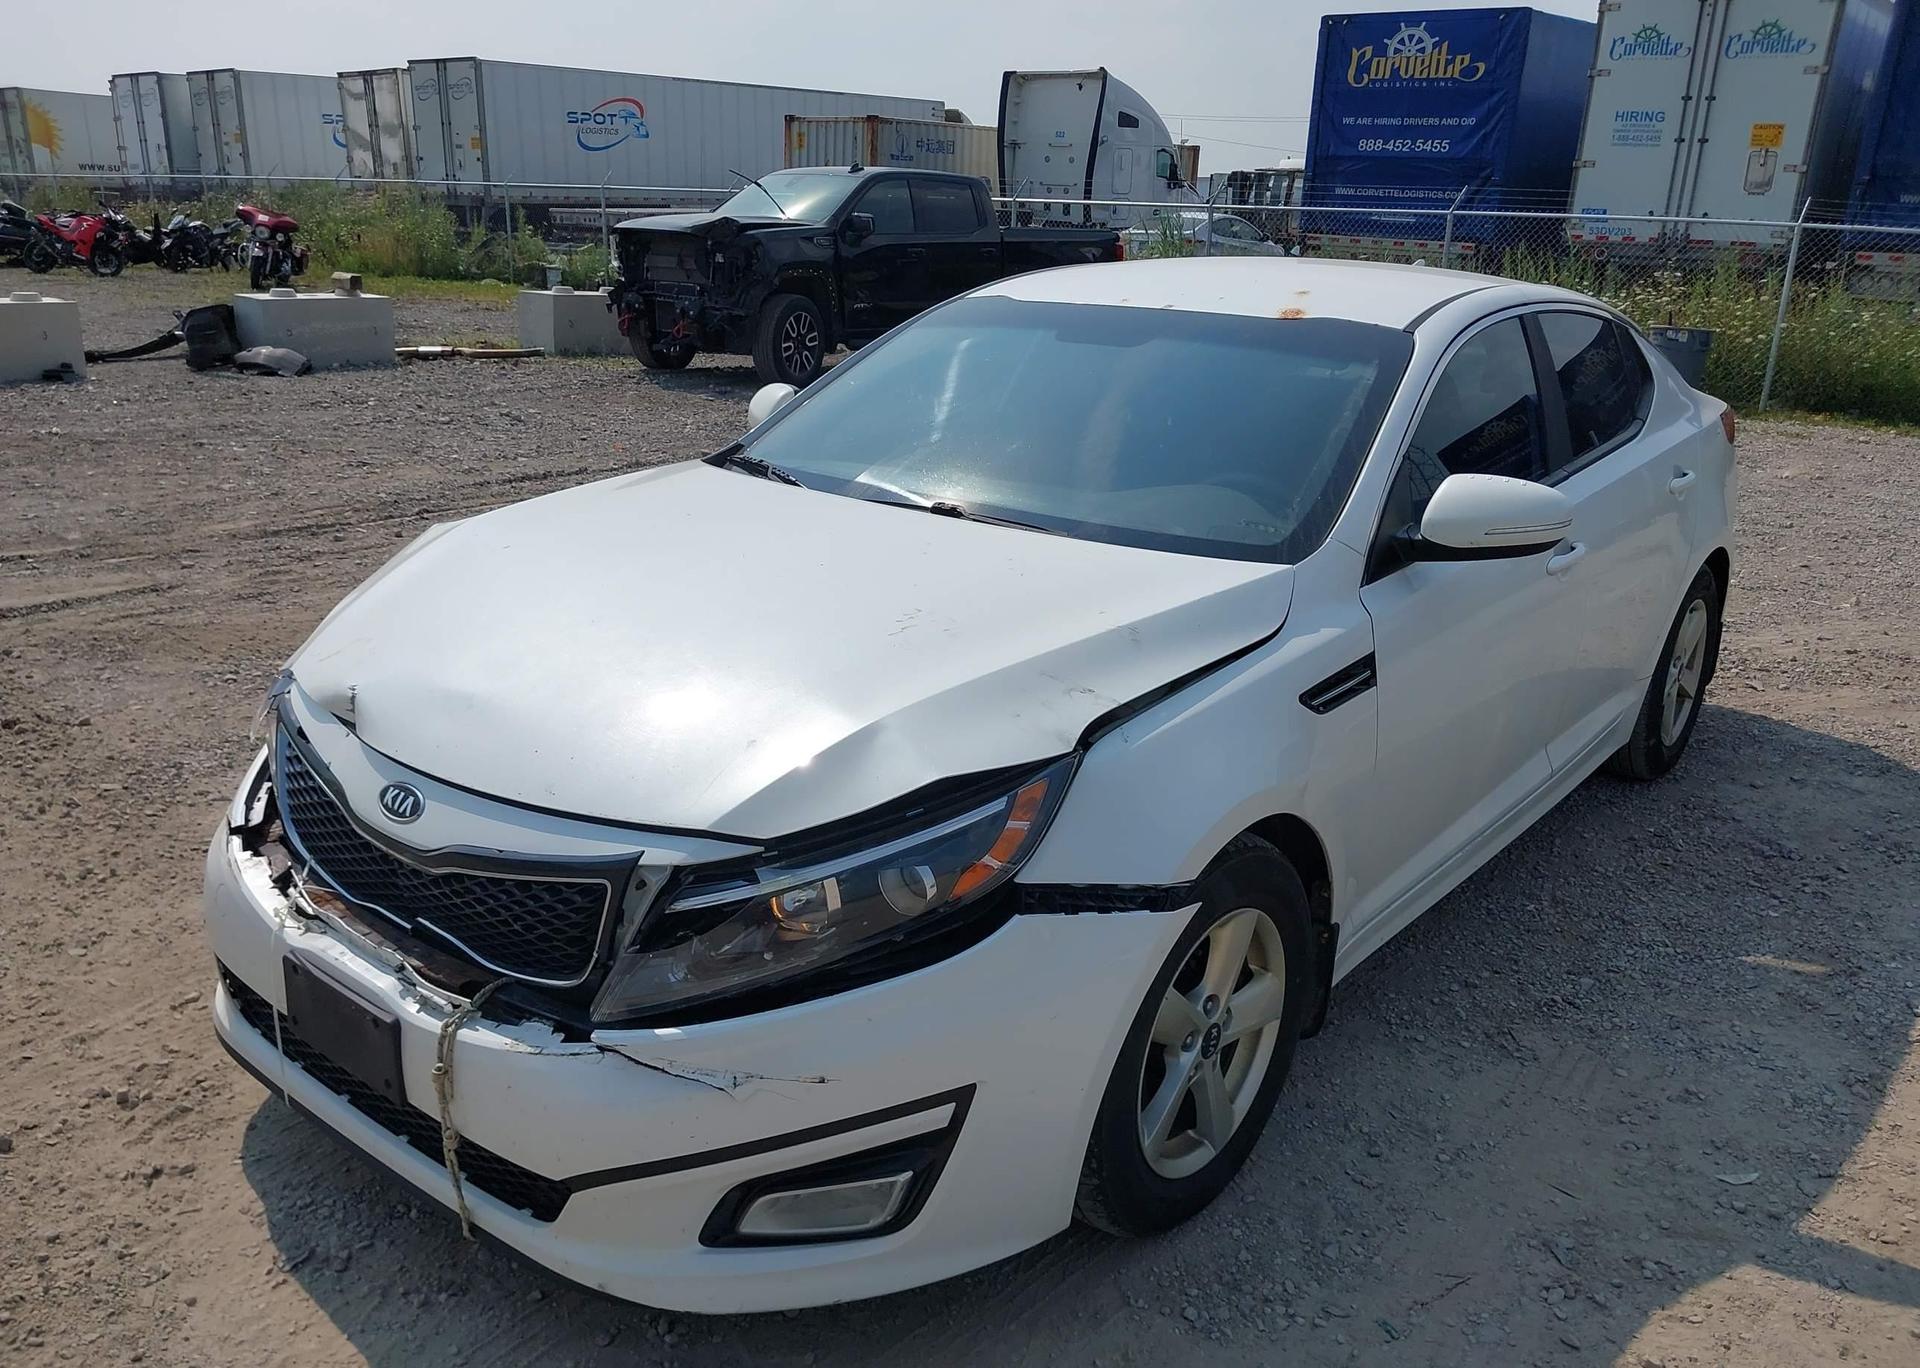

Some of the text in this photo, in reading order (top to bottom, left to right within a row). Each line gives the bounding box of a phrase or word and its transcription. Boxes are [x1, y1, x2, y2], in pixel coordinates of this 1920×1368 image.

[1608, 32, 1691, 62] Corvette
[1724, 30, 1817, 60] Corvette
[1347, 41, 1486, 87] Corvette
[566, 111, 618, 125] SPOT
[1343, 116, 1355, 125] WE
[1356, 117, 1373, 125] ARE
[1374, 117, 1402, 126] HIRING
[1403, 117, 1440, 126] DRIVERS
[1440, 117, 1460, 126] AND
[1615, 110, 1666, 123] HIRING
[581, 127, 620, 136] LOGISTICS
[1358, 139, 1451, 152] 888-452-5455
[383, 786, 415, 817] KIA
